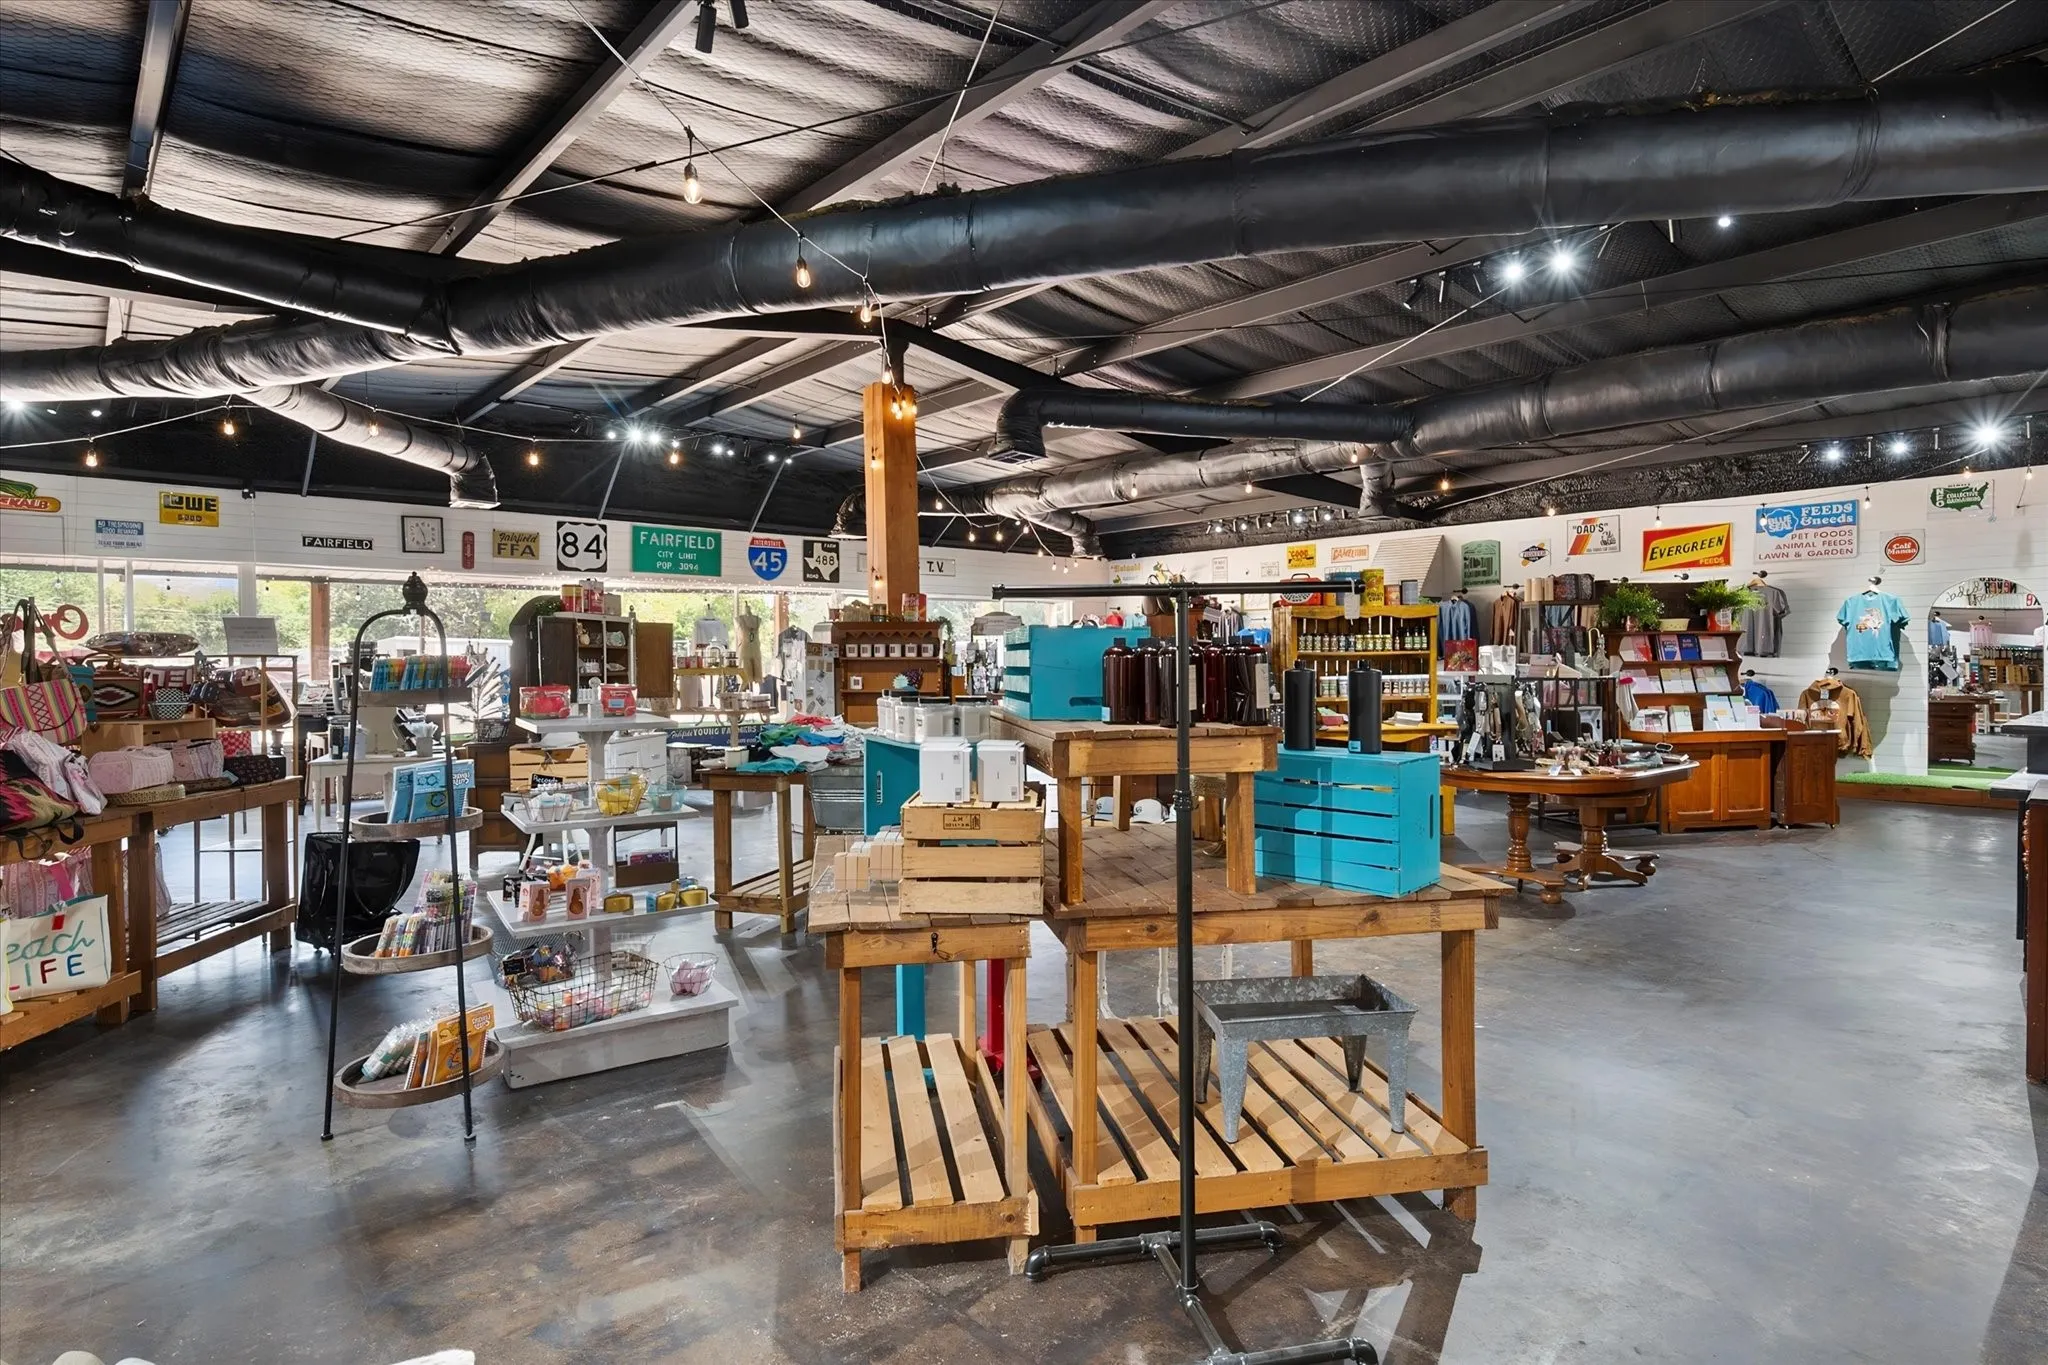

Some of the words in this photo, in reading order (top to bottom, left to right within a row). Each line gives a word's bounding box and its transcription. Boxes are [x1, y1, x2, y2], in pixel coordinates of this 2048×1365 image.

[1801, 502, 1853, 517] FEEDS
[640, 531, 715, 550] FAIRFIELD
[1791, 532, 1809, 541] PET
[1813, 530, 1854, 539] FOODS
[305, 537, 371, 550] FAIRFIELD
[561, 532, 603, 560] 84
[753, 539, 781, 547] INTERSTATE
[1649, 535, 1725, 561] EVERGREEN
[1775, 541, 1817, 550] ANIMAL
[1822, 539, 1854, 547] FEEDS
[497, 542, 536, 557] FFA
[657, 550, 674, 558] CITY
[678, 552, 697, 560] LIMIT
[1758, 552, 1789, 560] LAWN
[1807, 548, 1854, 557] GARDEN
[753, 551, 783, 572] 45
[815, 555, 835, 566] 488
[1700, 557, 1725, 565] FEEDS
[693, 727, 720, 736] YOUNG
